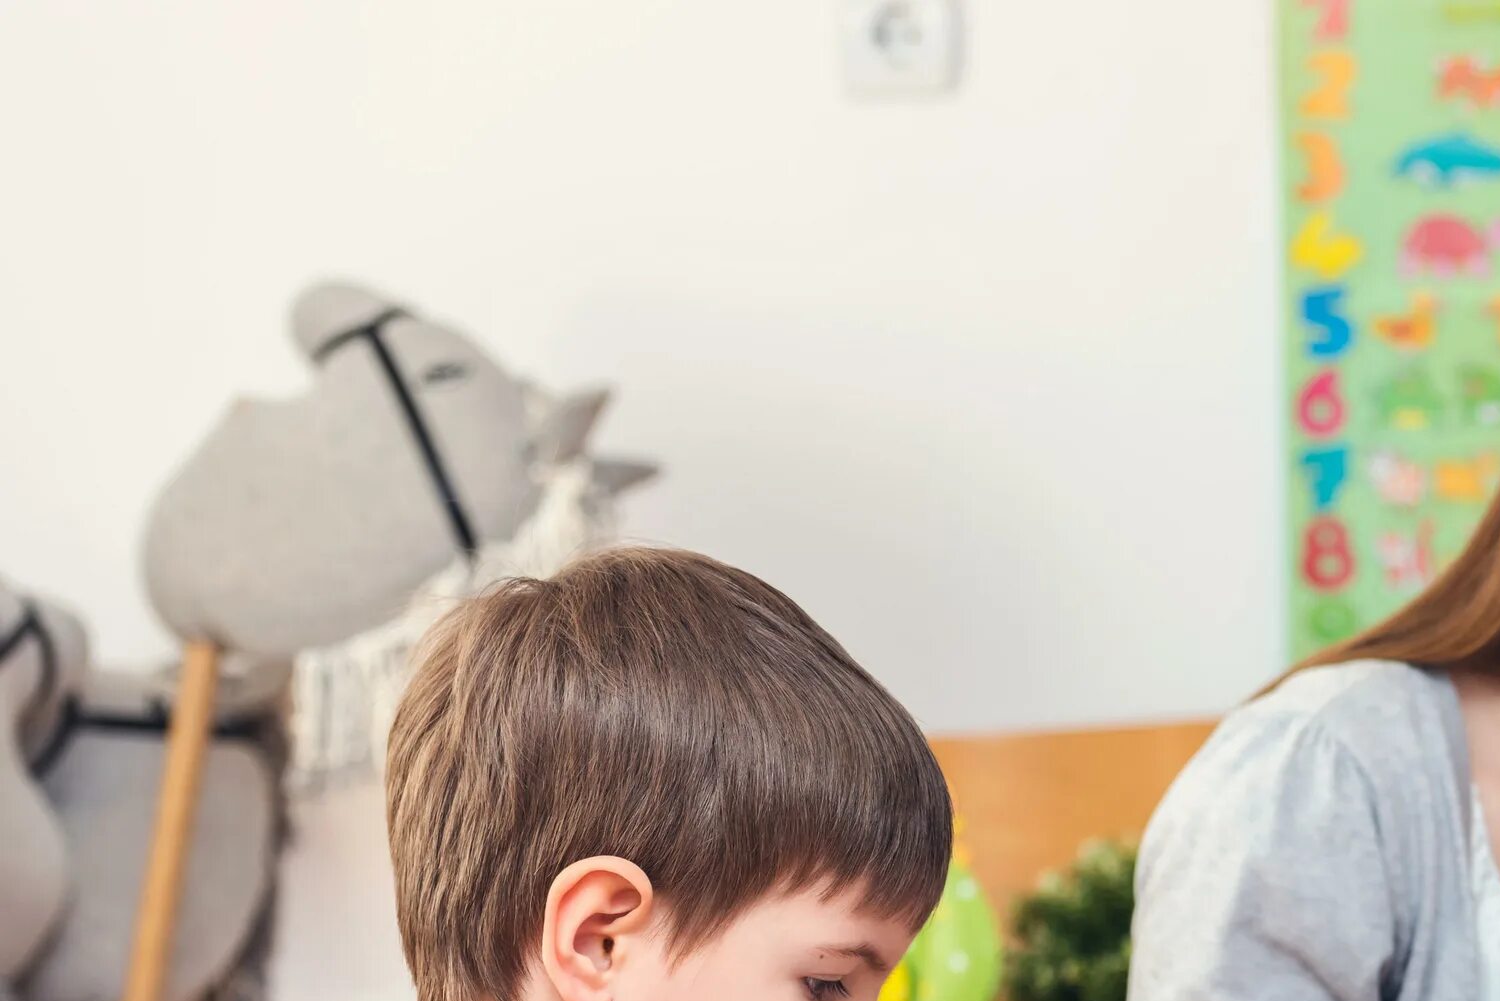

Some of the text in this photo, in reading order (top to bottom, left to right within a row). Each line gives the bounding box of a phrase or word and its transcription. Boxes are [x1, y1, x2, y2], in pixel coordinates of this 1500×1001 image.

[1299, 52, 1357, 119] 2
[1293, 131, 1345, 203] 3
[1300, 288, 1352, 357] 5
[1295, 370, 1346, 438] 6
[1302, 448, 1348, 508] 7
[1302, 517, 1355, 591] 8
